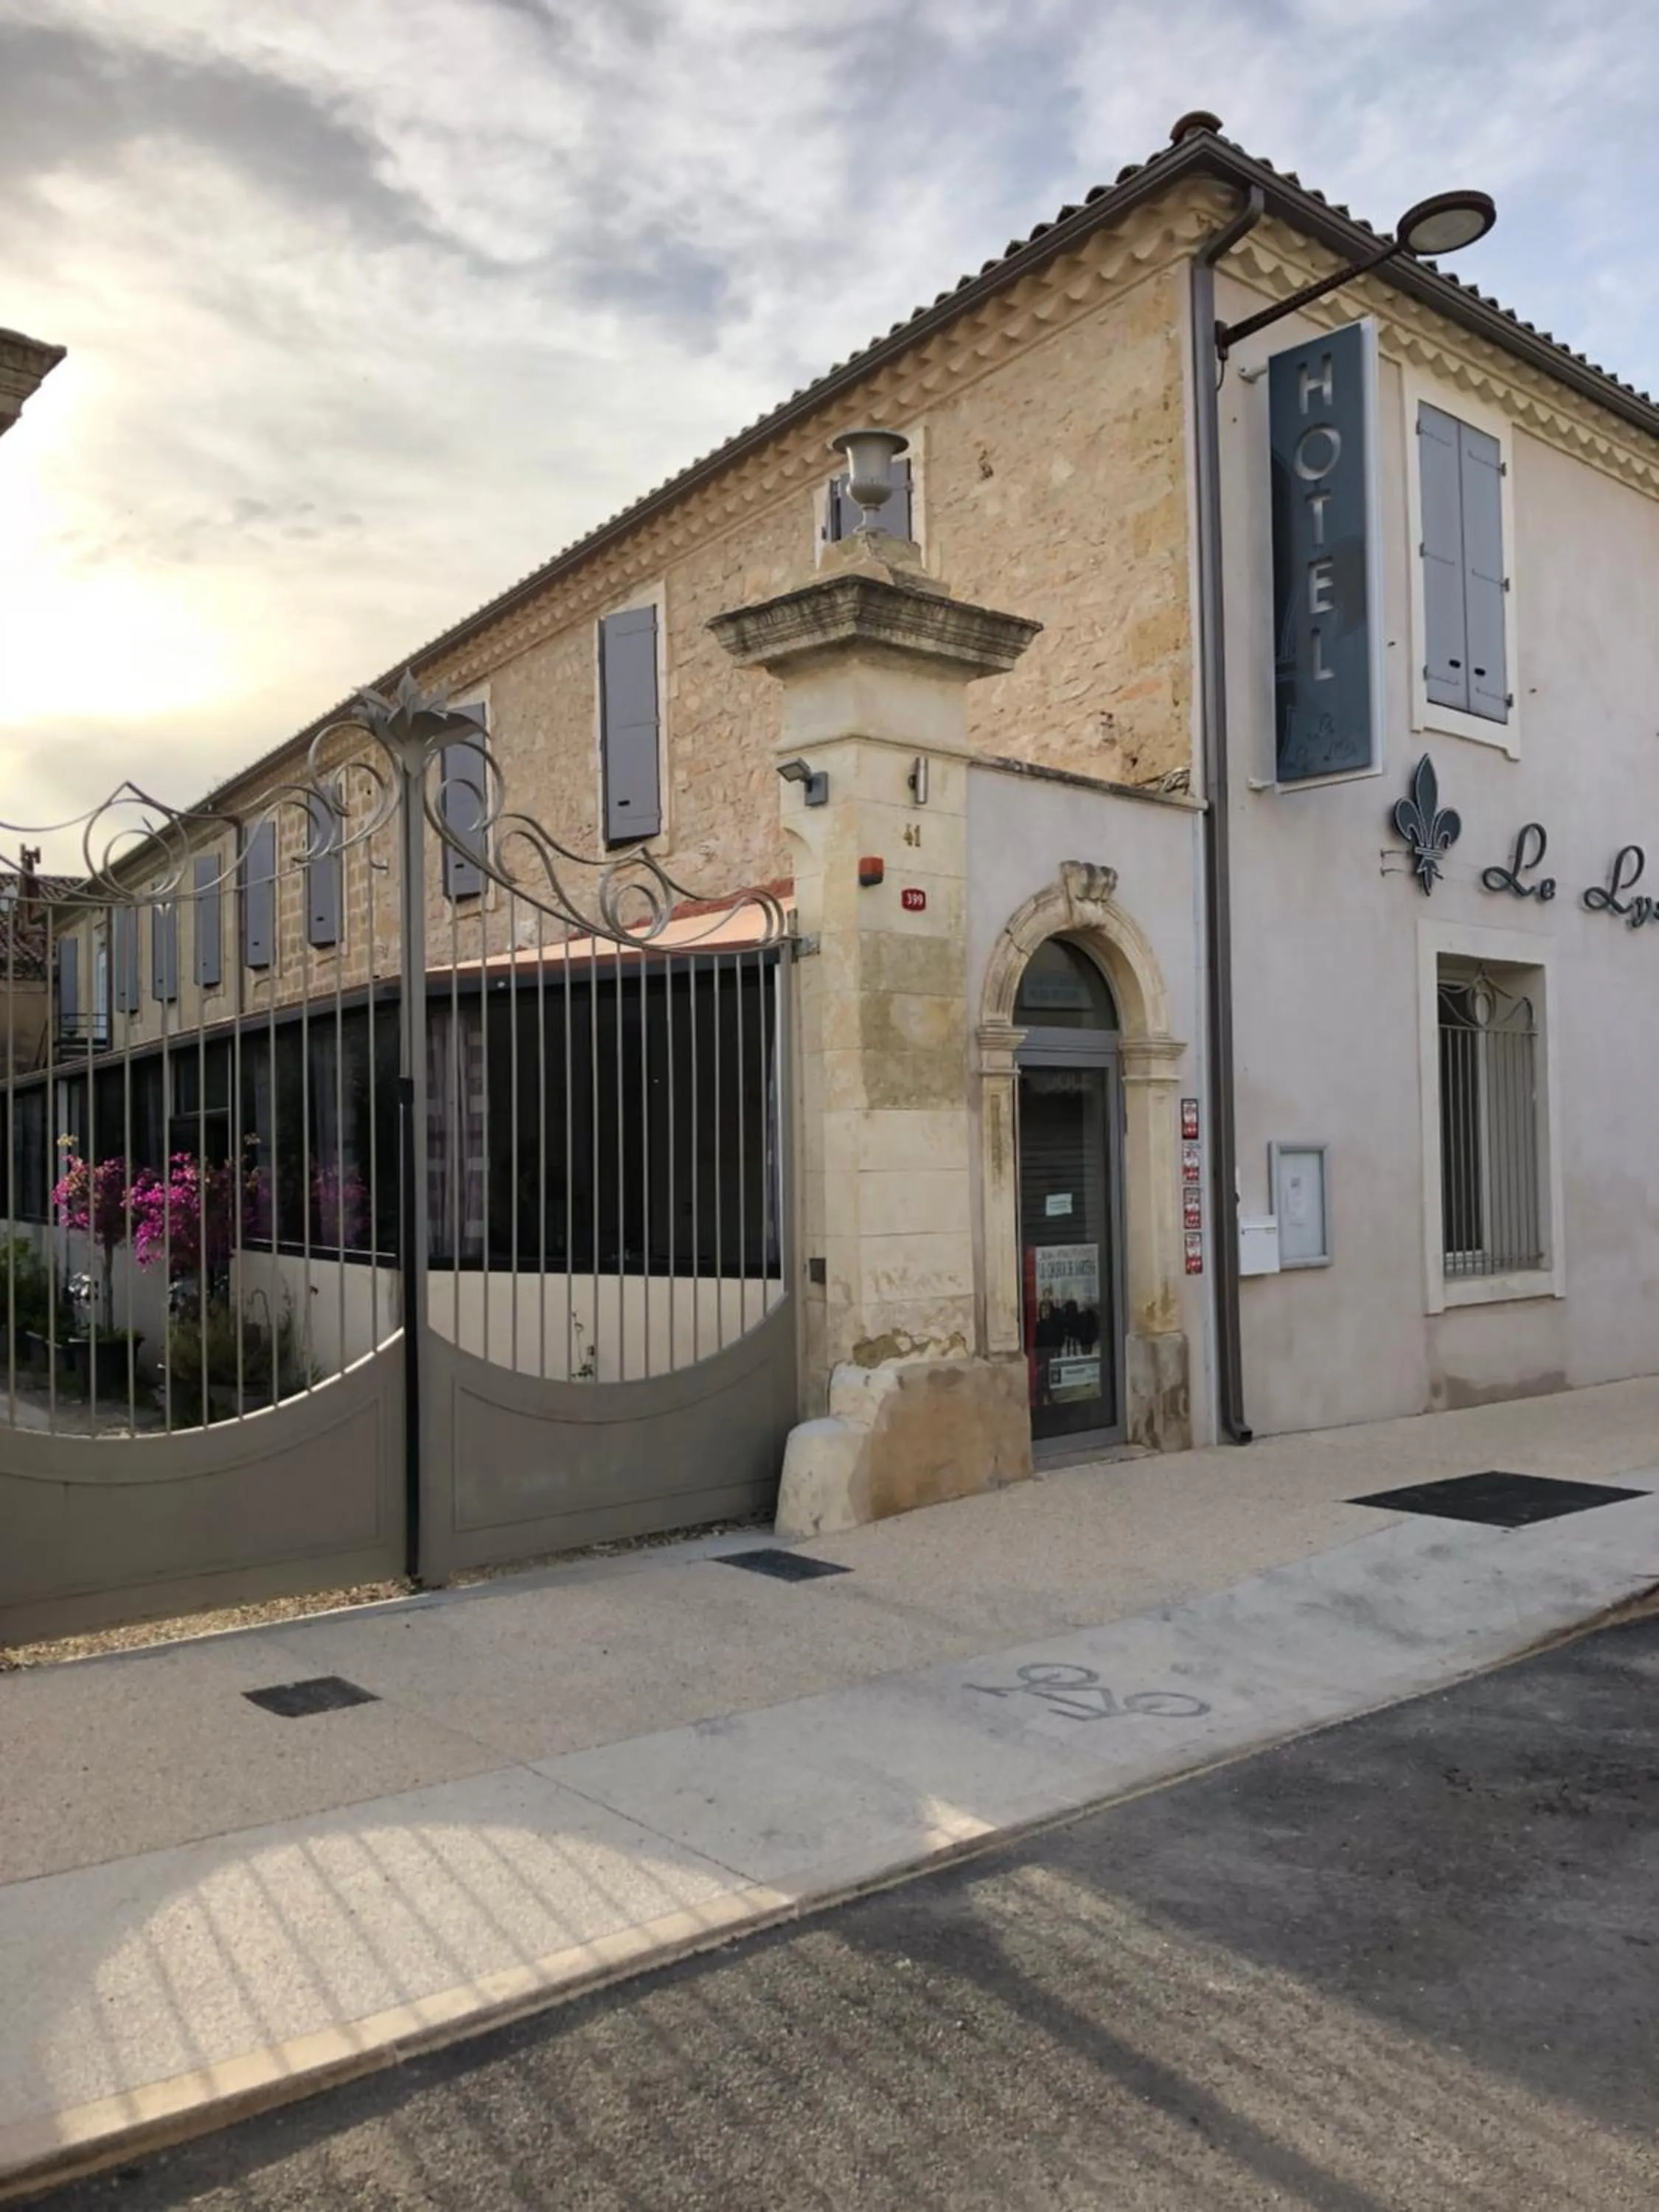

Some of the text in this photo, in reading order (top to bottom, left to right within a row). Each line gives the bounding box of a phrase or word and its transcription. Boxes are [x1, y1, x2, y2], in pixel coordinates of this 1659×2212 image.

[1293, 353, 1341, 681] HOTEL
[903, 824, 921, 847] 41
[1482, 822, 1556, 901] Le
